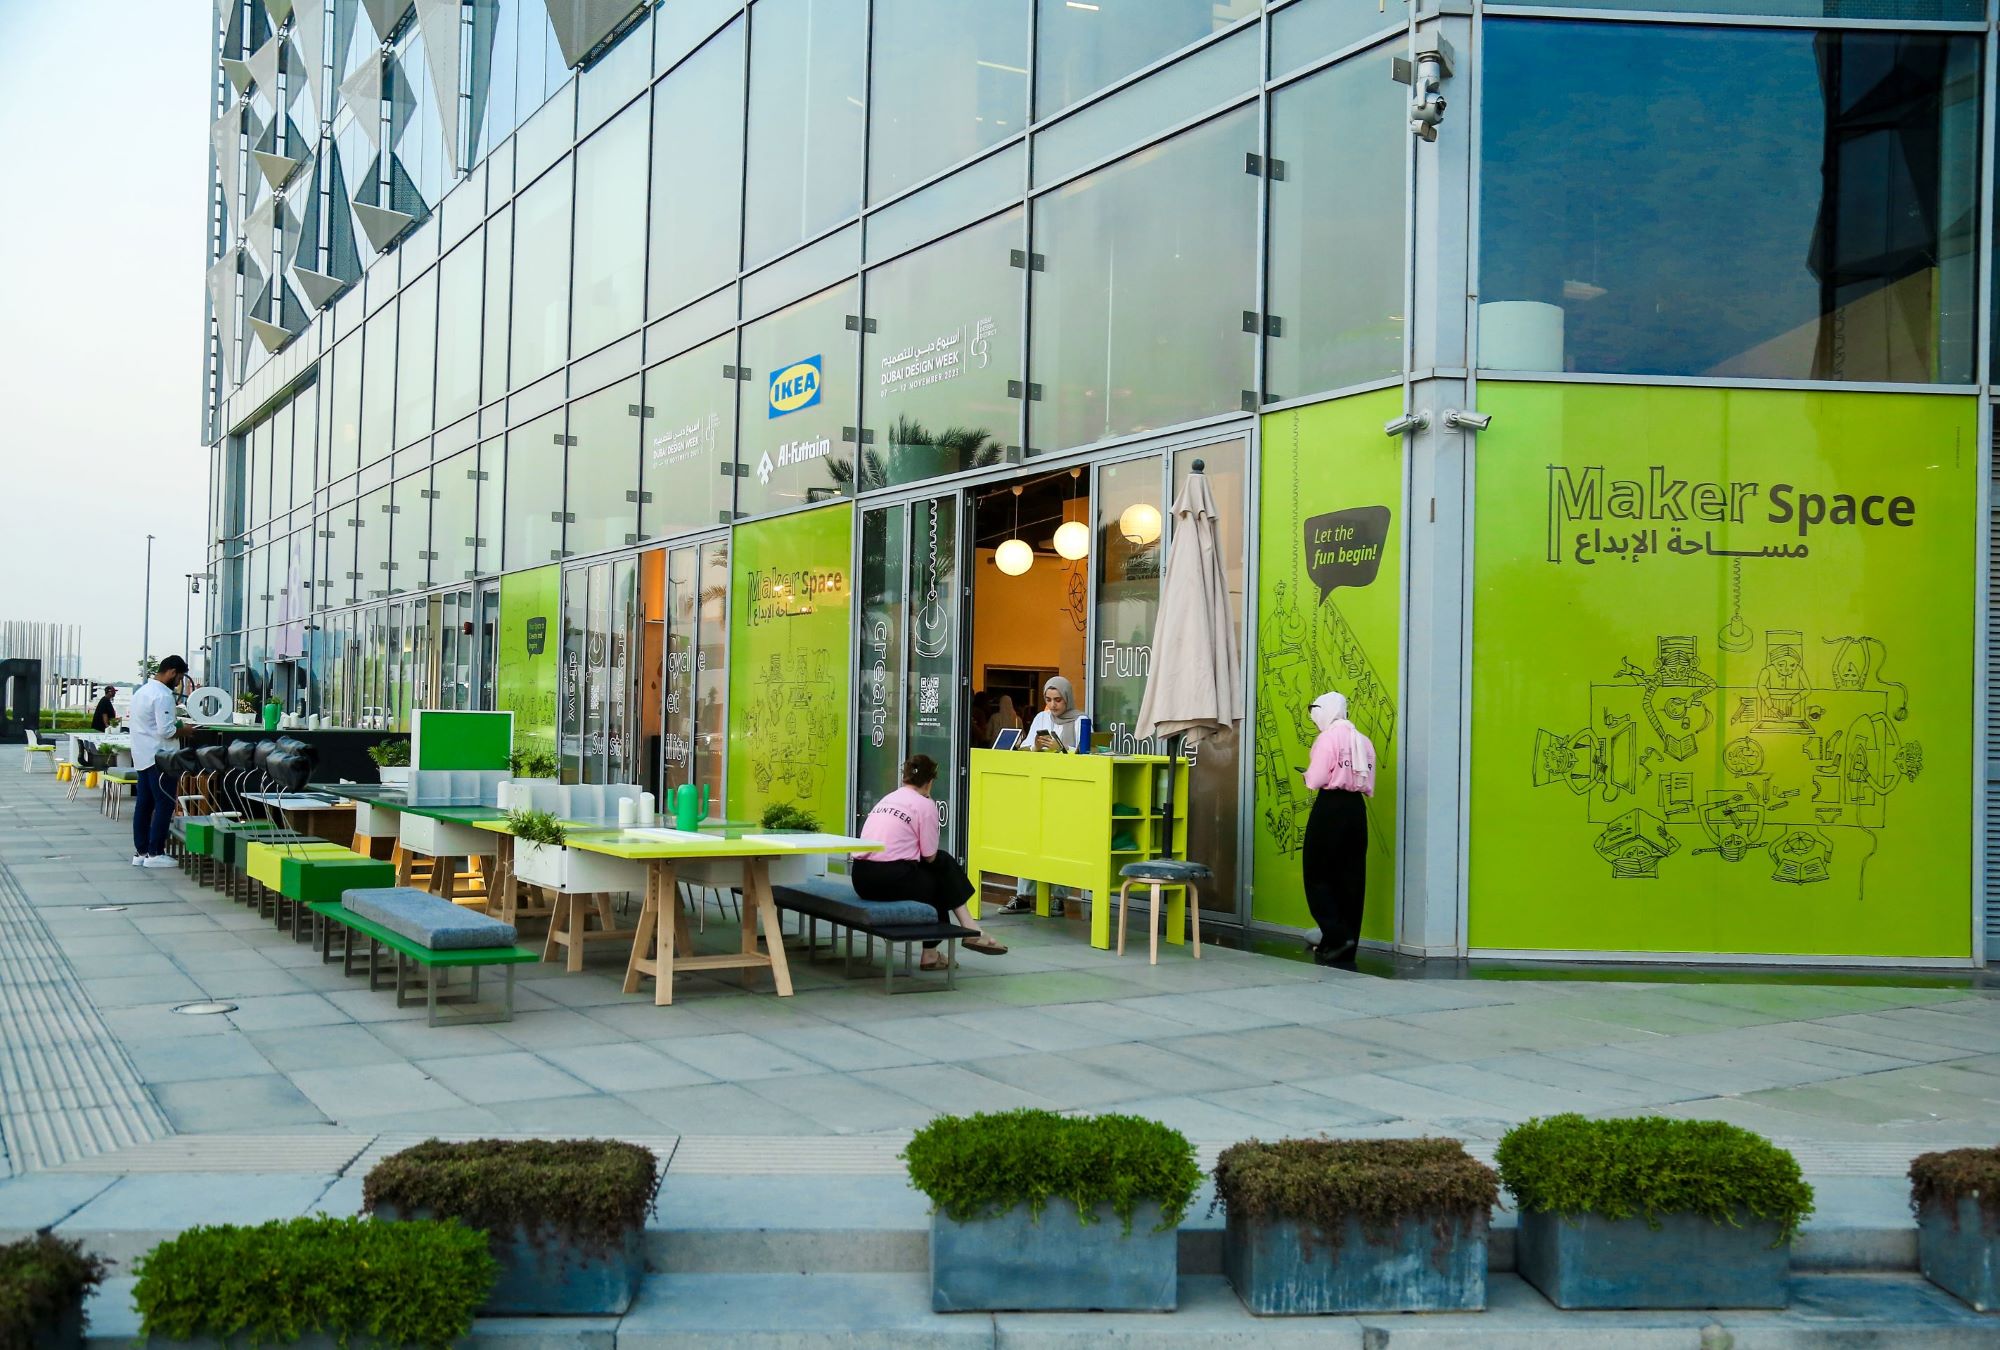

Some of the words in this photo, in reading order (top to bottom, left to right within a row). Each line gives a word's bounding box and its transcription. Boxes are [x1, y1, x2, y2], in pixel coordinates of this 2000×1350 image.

[881, 368, 905, 385] DUBAI
[905, 359, 935, 379] DESIGN
[935, 351, 960, 369] WEEK
[909, 373, 942, 390] NOVEMBER
[944, 368, 960, 380] 2023
[774, 371, 816, 403] IKEA
[777, 434, 831, 468] Al-Futtaim
[1546, 465, 1759, 563] Maker
[1768, 483, 1916, 537] Space
[1314, 528, 1333, 544] Let
[1335, 524, 1354, 542] the
[1574, 527, 1657, 565] الإبداع
[1312, 548, 1335, 570] fun
[1337, 543, 1378, 566] begin!
[746, 566, 800, 626] Maker
[801, 570, 843, 601] Space
[1100, 639, 1153, 678] Fun
[871, 621, 887, 748] create
